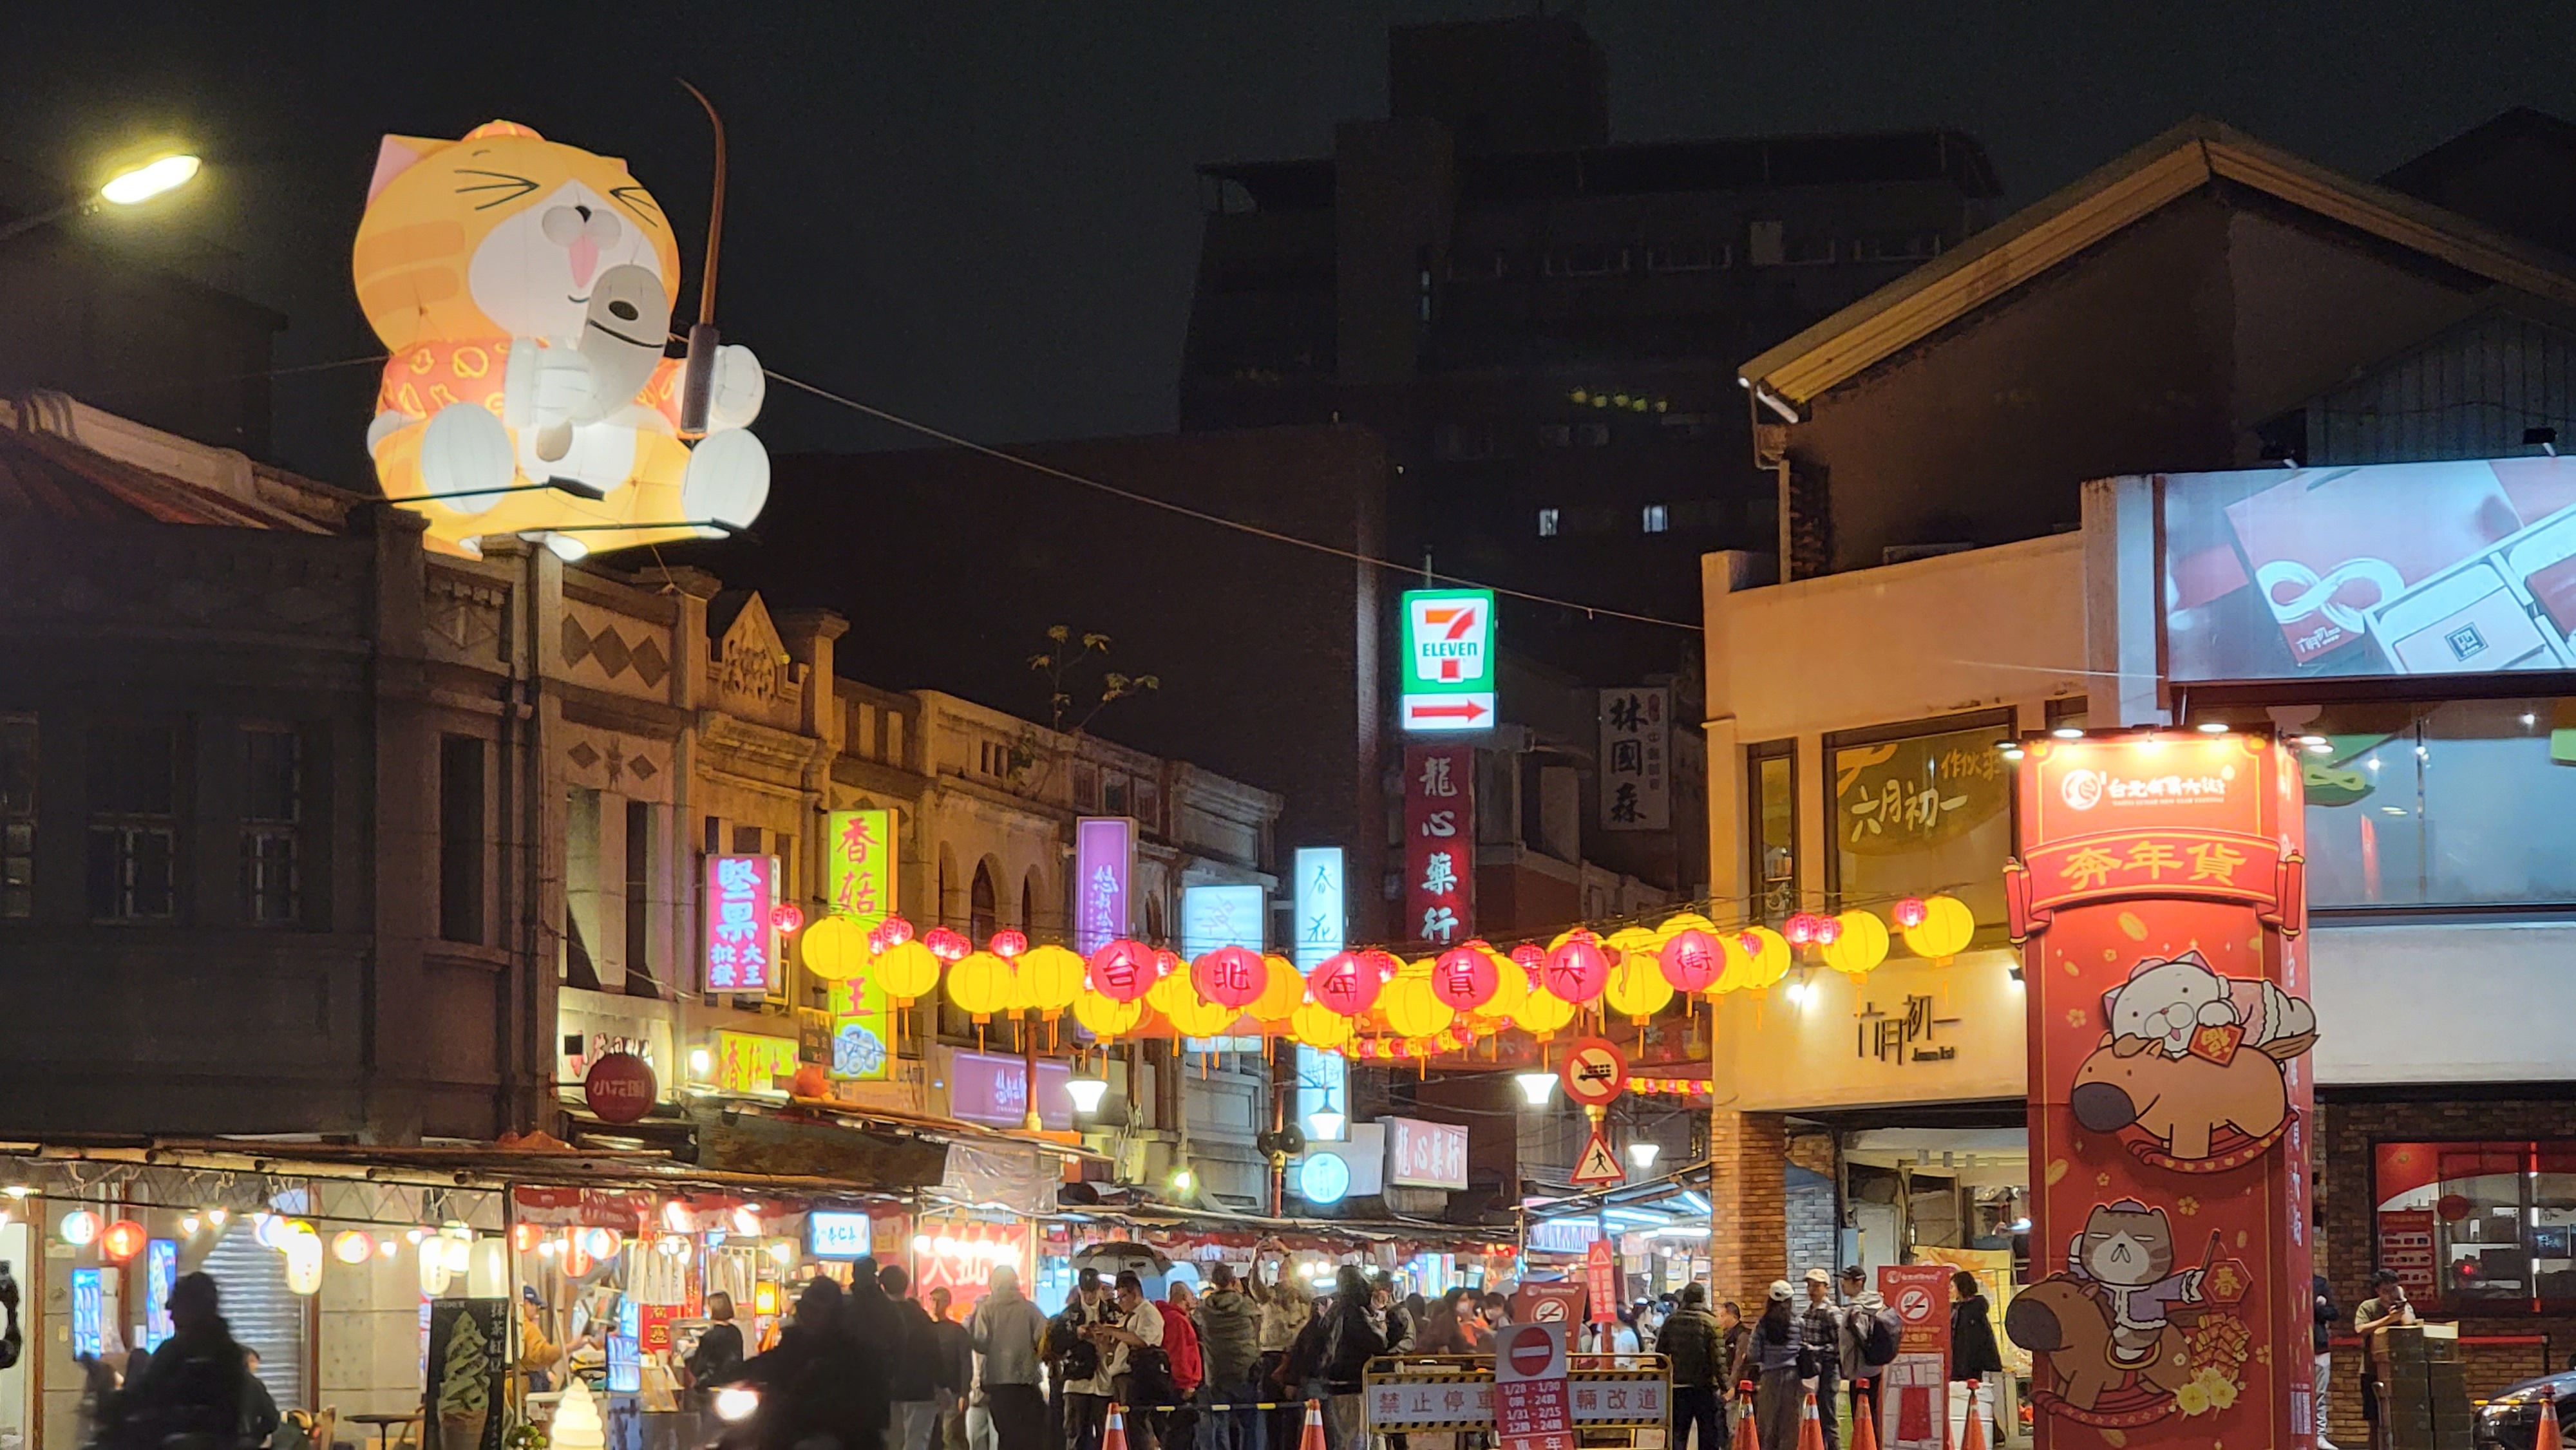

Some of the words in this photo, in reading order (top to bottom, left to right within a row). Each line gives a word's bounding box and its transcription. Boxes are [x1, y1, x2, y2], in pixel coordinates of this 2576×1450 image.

[1425, 607, 1475, 679] 7
[1610, 692, 1648, 824] 林國森
[1850, 778, 1968, 843] 六月初一
[1419, 756, 1459, 945] 龍心藥行
[715, 858, 761, 943] 堅果
[836, 818, 878, 1017] 香菇王
[1306, 865, 1337, 943] 春花
[710, 942, 737, 986] 批發
[740, 942, 766, 985] 大王
[1103, 950, 1139, 987] 台
[1215, 962, 1250, 990] 北
[1549, 957, 1586, 985] 大
[1395, 1123, 1461, 1180] 龍心藥行
[2215, 1265, 2240, 1298] 春
[1379, 1389, 1497, 1413] 禁止停車
